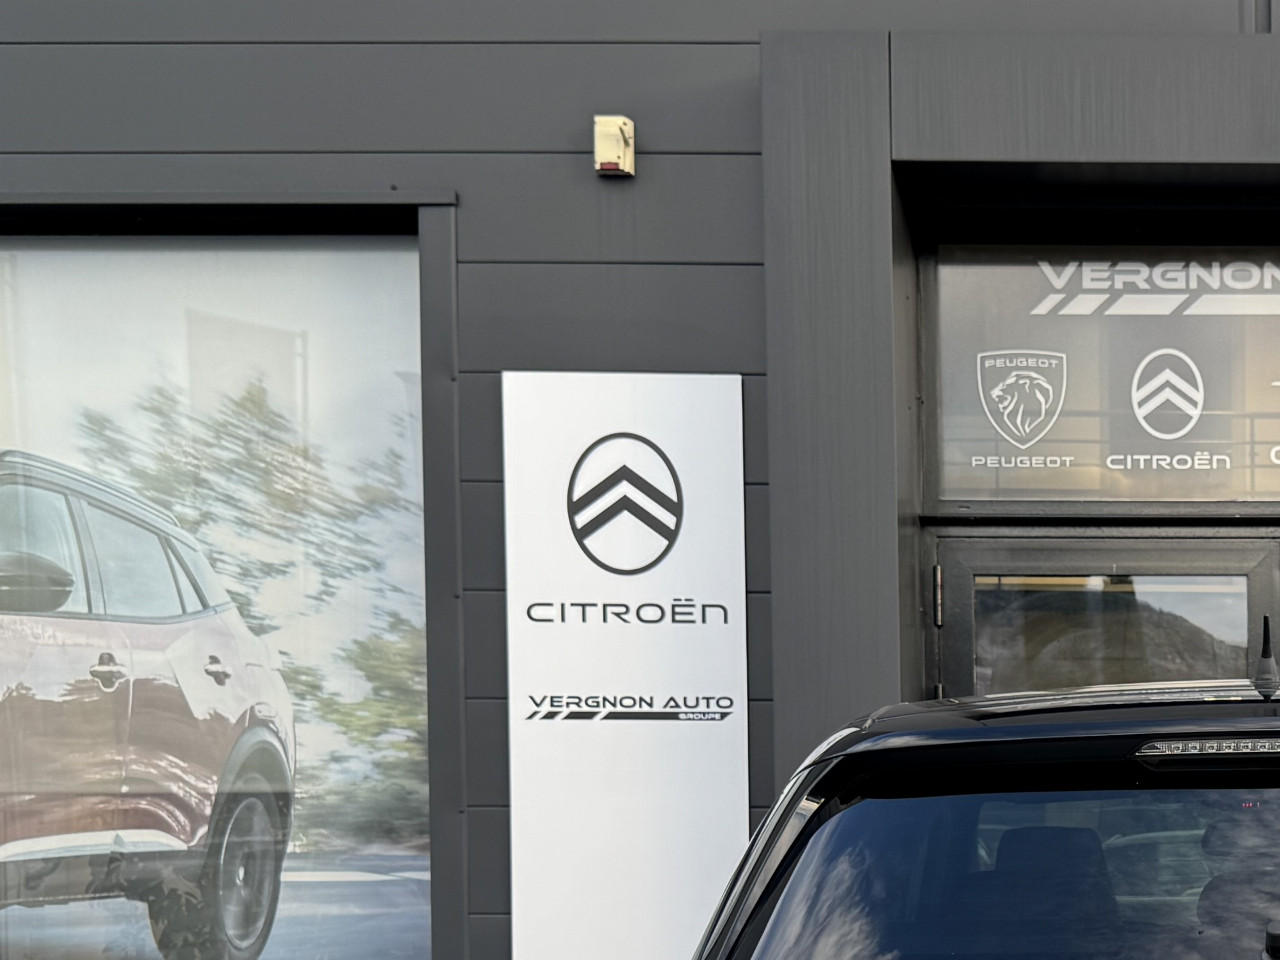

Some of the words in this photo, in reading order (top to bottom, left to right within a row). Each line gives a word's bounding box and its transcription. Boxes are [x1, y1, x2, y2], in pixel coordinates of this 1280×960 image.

[983, 357, 1059, 369] PEUGEOT
[971, 455, 1075, 468] PEUGEOT
[528, 695, 654, 710] VERGNON
[662, 695, 734, 709] AUTO
